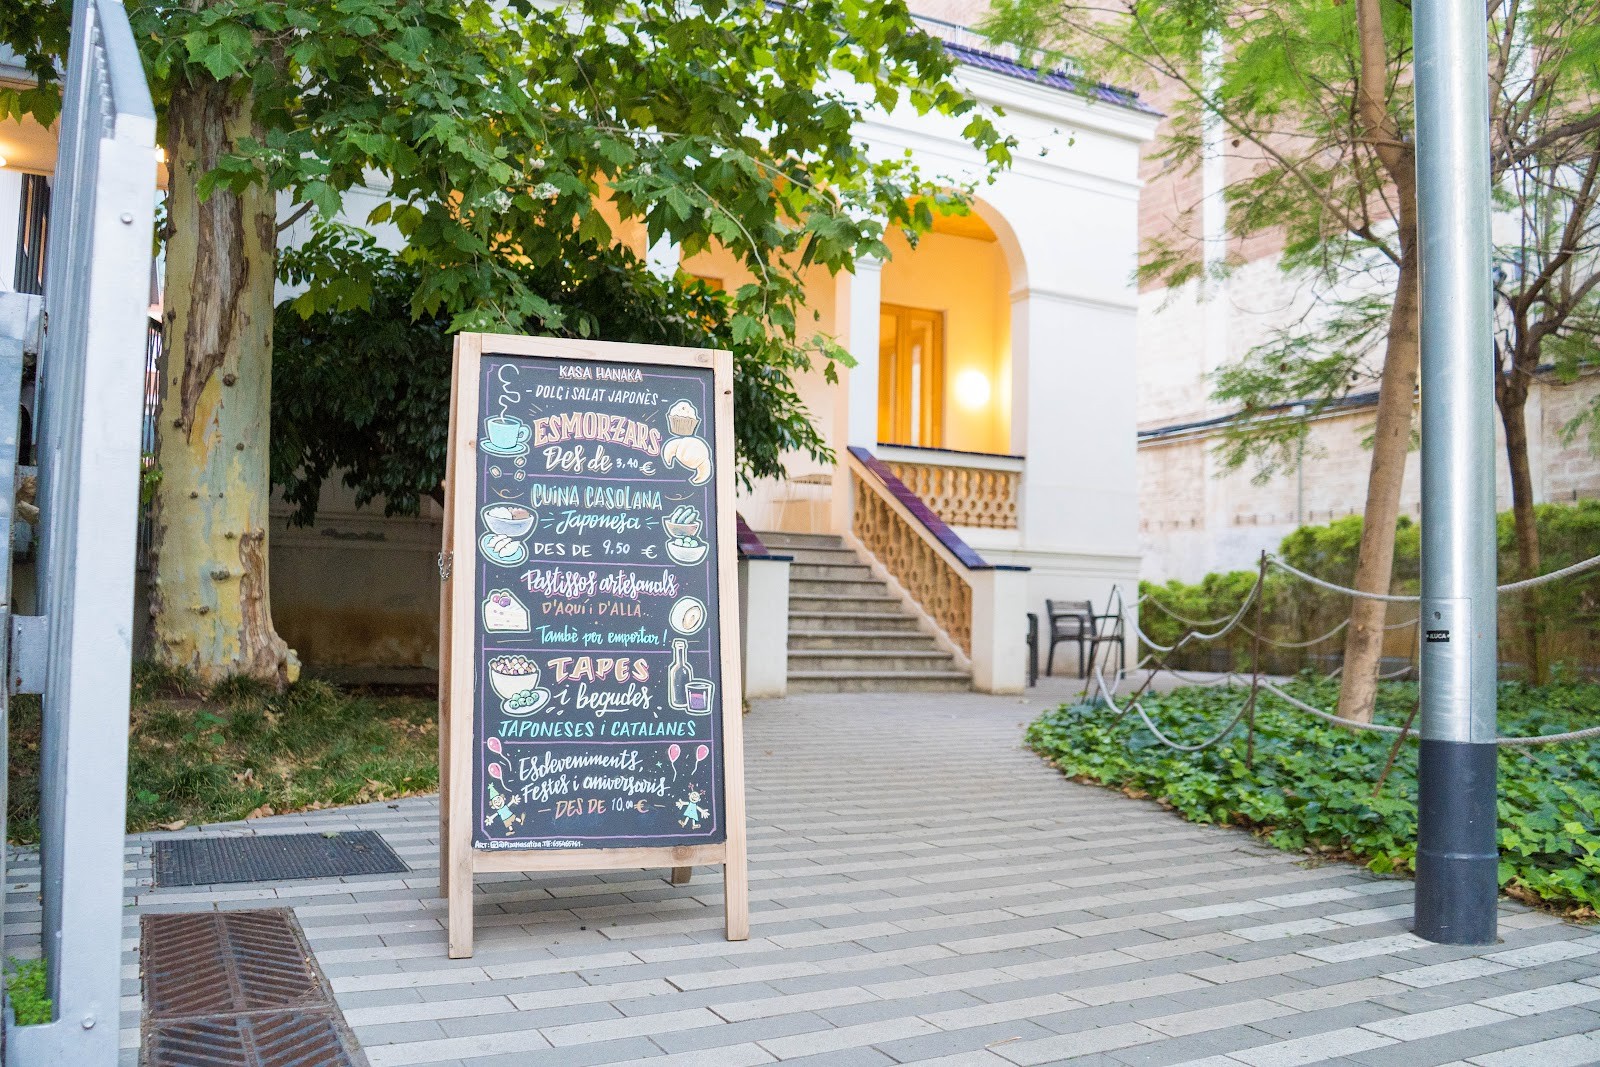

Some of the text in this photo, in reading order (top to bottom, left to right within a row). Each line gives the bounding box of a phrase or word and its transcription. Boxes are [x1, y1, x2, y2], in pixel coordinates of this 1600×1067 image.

[559, 365, 643, 382] KASA HANAKA
[535, 385, 563, 400] DOLÇ
[571, 387, 607, 402] SALAT
[608, 389, 659, 405] JAPONÈS
[533, 411, 662, 457] ESMORZARS
[587, 444, 613, 474] de
[585, 485, 663, 511] CASOLANA
[555, 509, 642, 536] Japonesa
[534, 542, 566, 556] DES
[572, 544, 593, 557] DE
[641, 544, 658, 559] €
[520, 566, 679, 600] Pastissos artesanals
[582, 633, 603, 647] per
[608, 625, 660, 647] emportar
[547, 655, 650, 684] TAPES
[553, 682, 653, 717] i begudes
[498, 719, 595, 738] JAPONESES
[611, 719, 696, 737] CATALANES
[518, 749, 644, 782] Esdeveniments,
[521, 773, 570, 804] Festes
[555, 797, 583, 820] DES
[587, 798, 607, 815] DE
